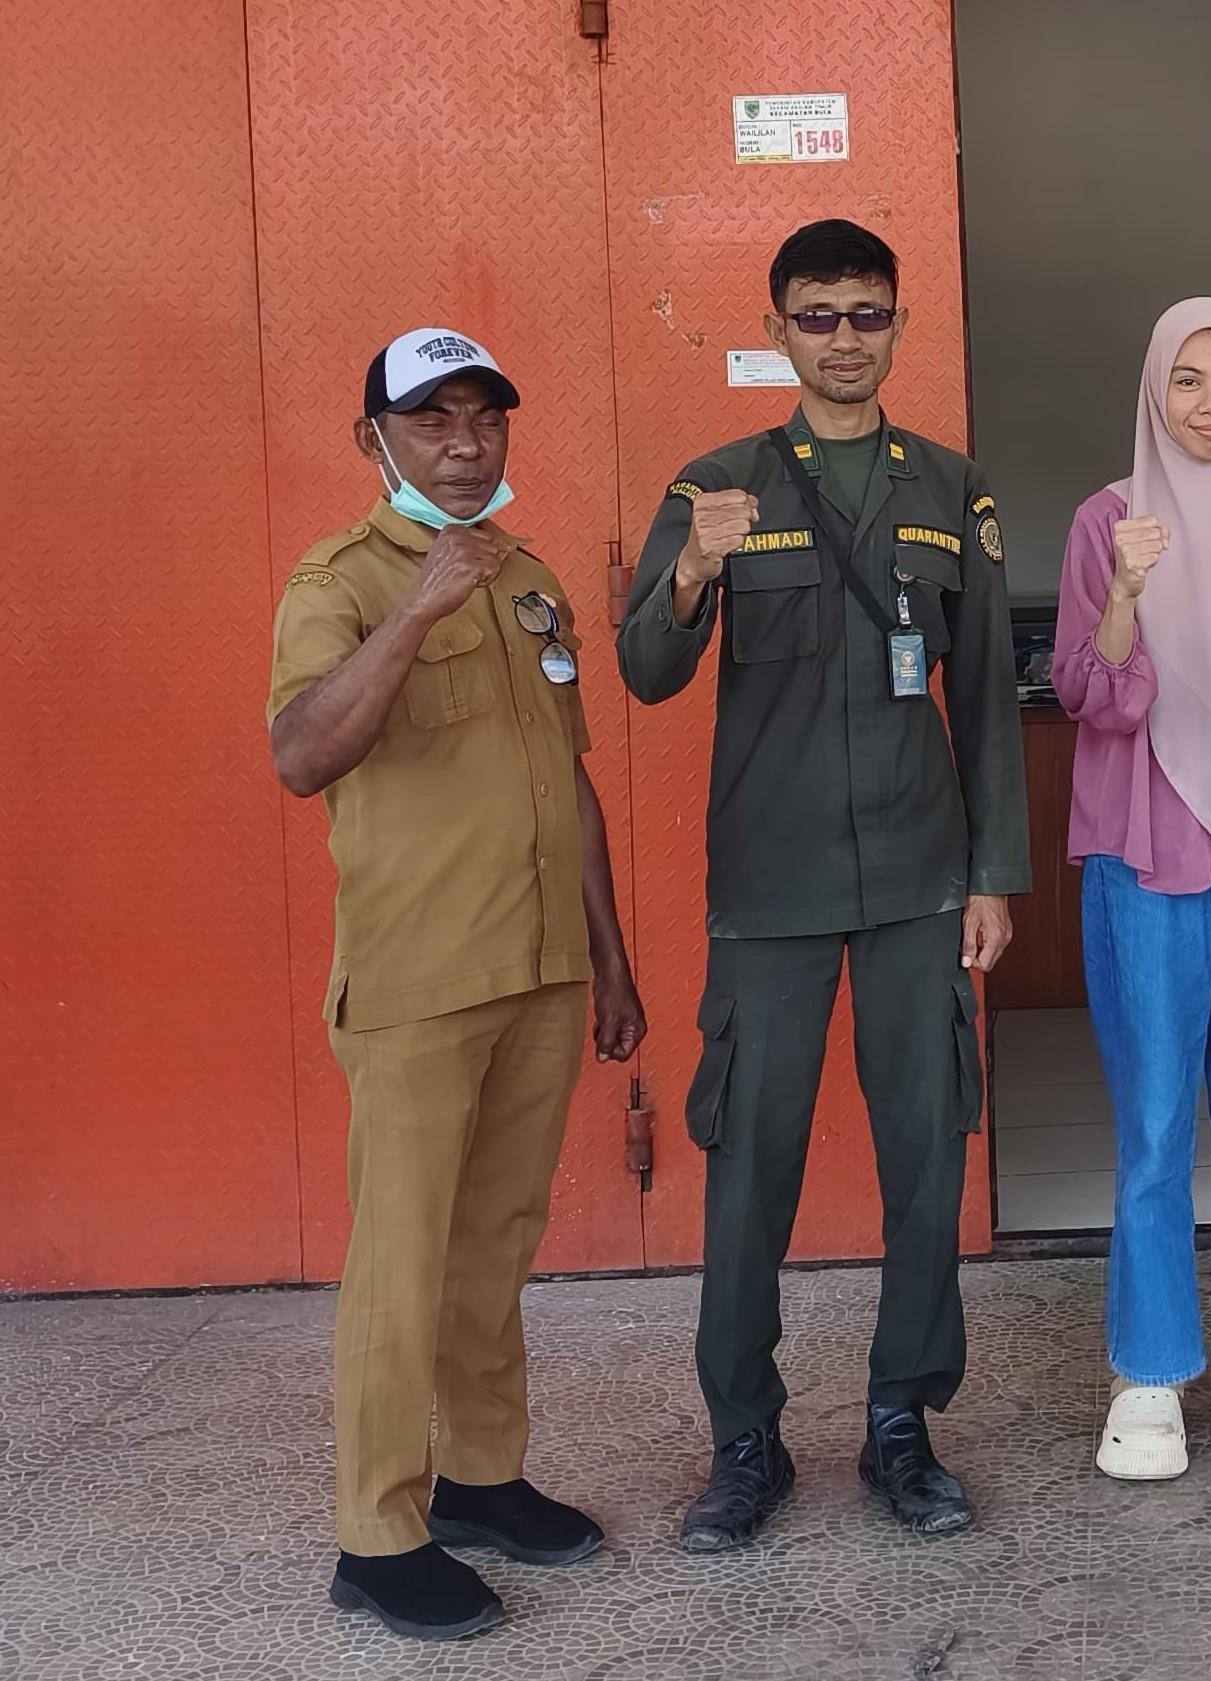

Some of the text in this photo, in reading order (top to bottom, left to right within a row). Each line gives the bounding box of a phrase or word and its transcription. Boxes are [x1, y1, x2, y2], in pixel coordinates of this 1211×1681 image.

[794, 129, 844, 155] 1548
[415, 337, 444, 359] YOUTH
[428, 347, 475, 362] FOREVER
[736, 530, 810, 552] AHMADI
[898, 527, 961, 555] QUARANTI
